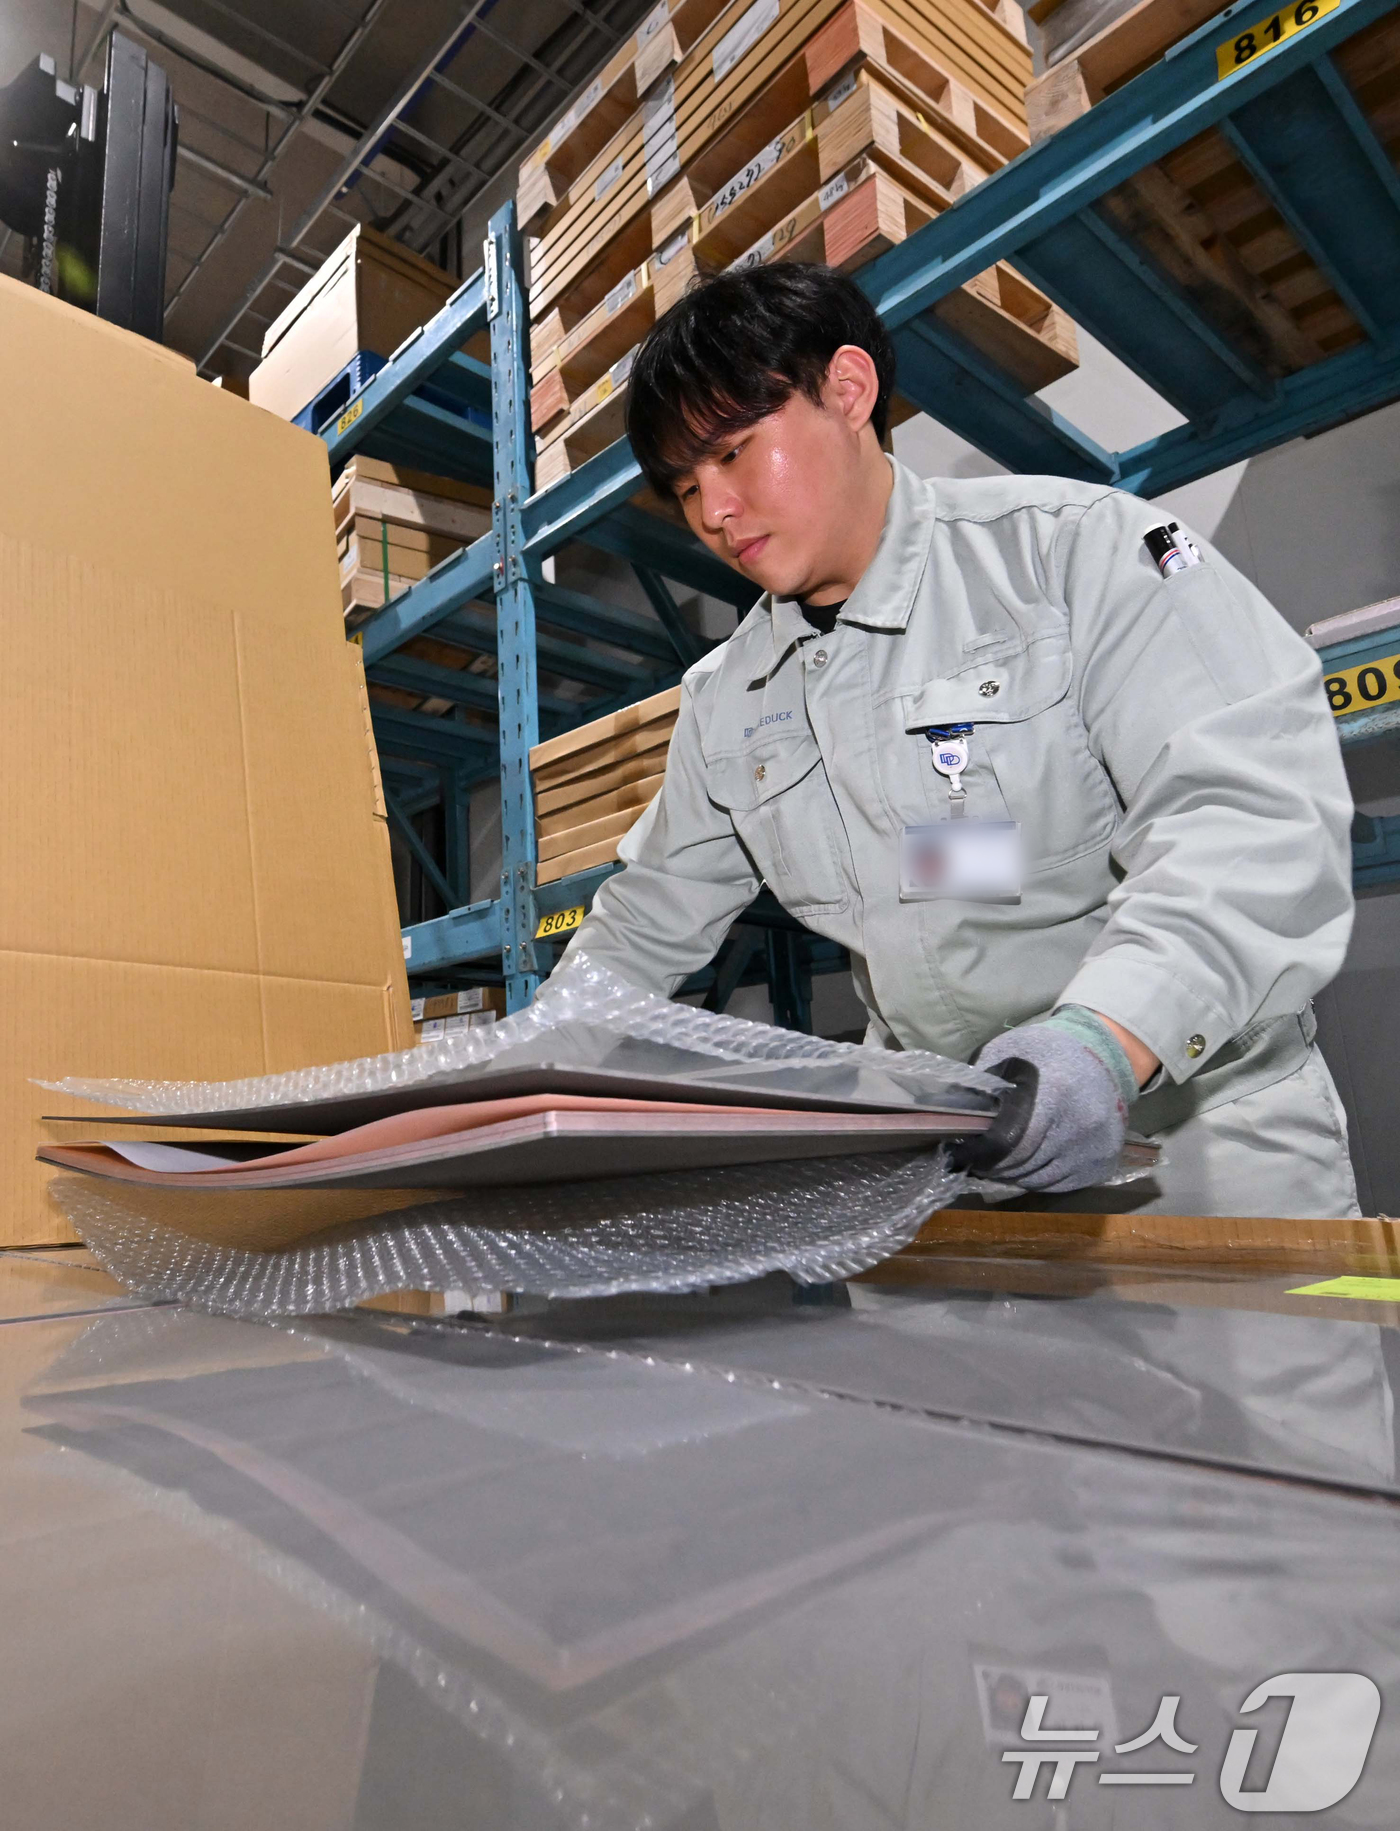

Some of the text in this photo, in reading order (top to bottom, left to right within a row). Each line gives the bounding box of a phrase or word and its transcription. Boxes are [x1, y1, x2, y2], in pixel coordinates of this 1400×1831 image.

[1234, 0, 1319, 65] 816
[341, 404, 359, 430] 826
[1324, 659, 1400, 712] 80
[543, 909, 577, 933] 803
